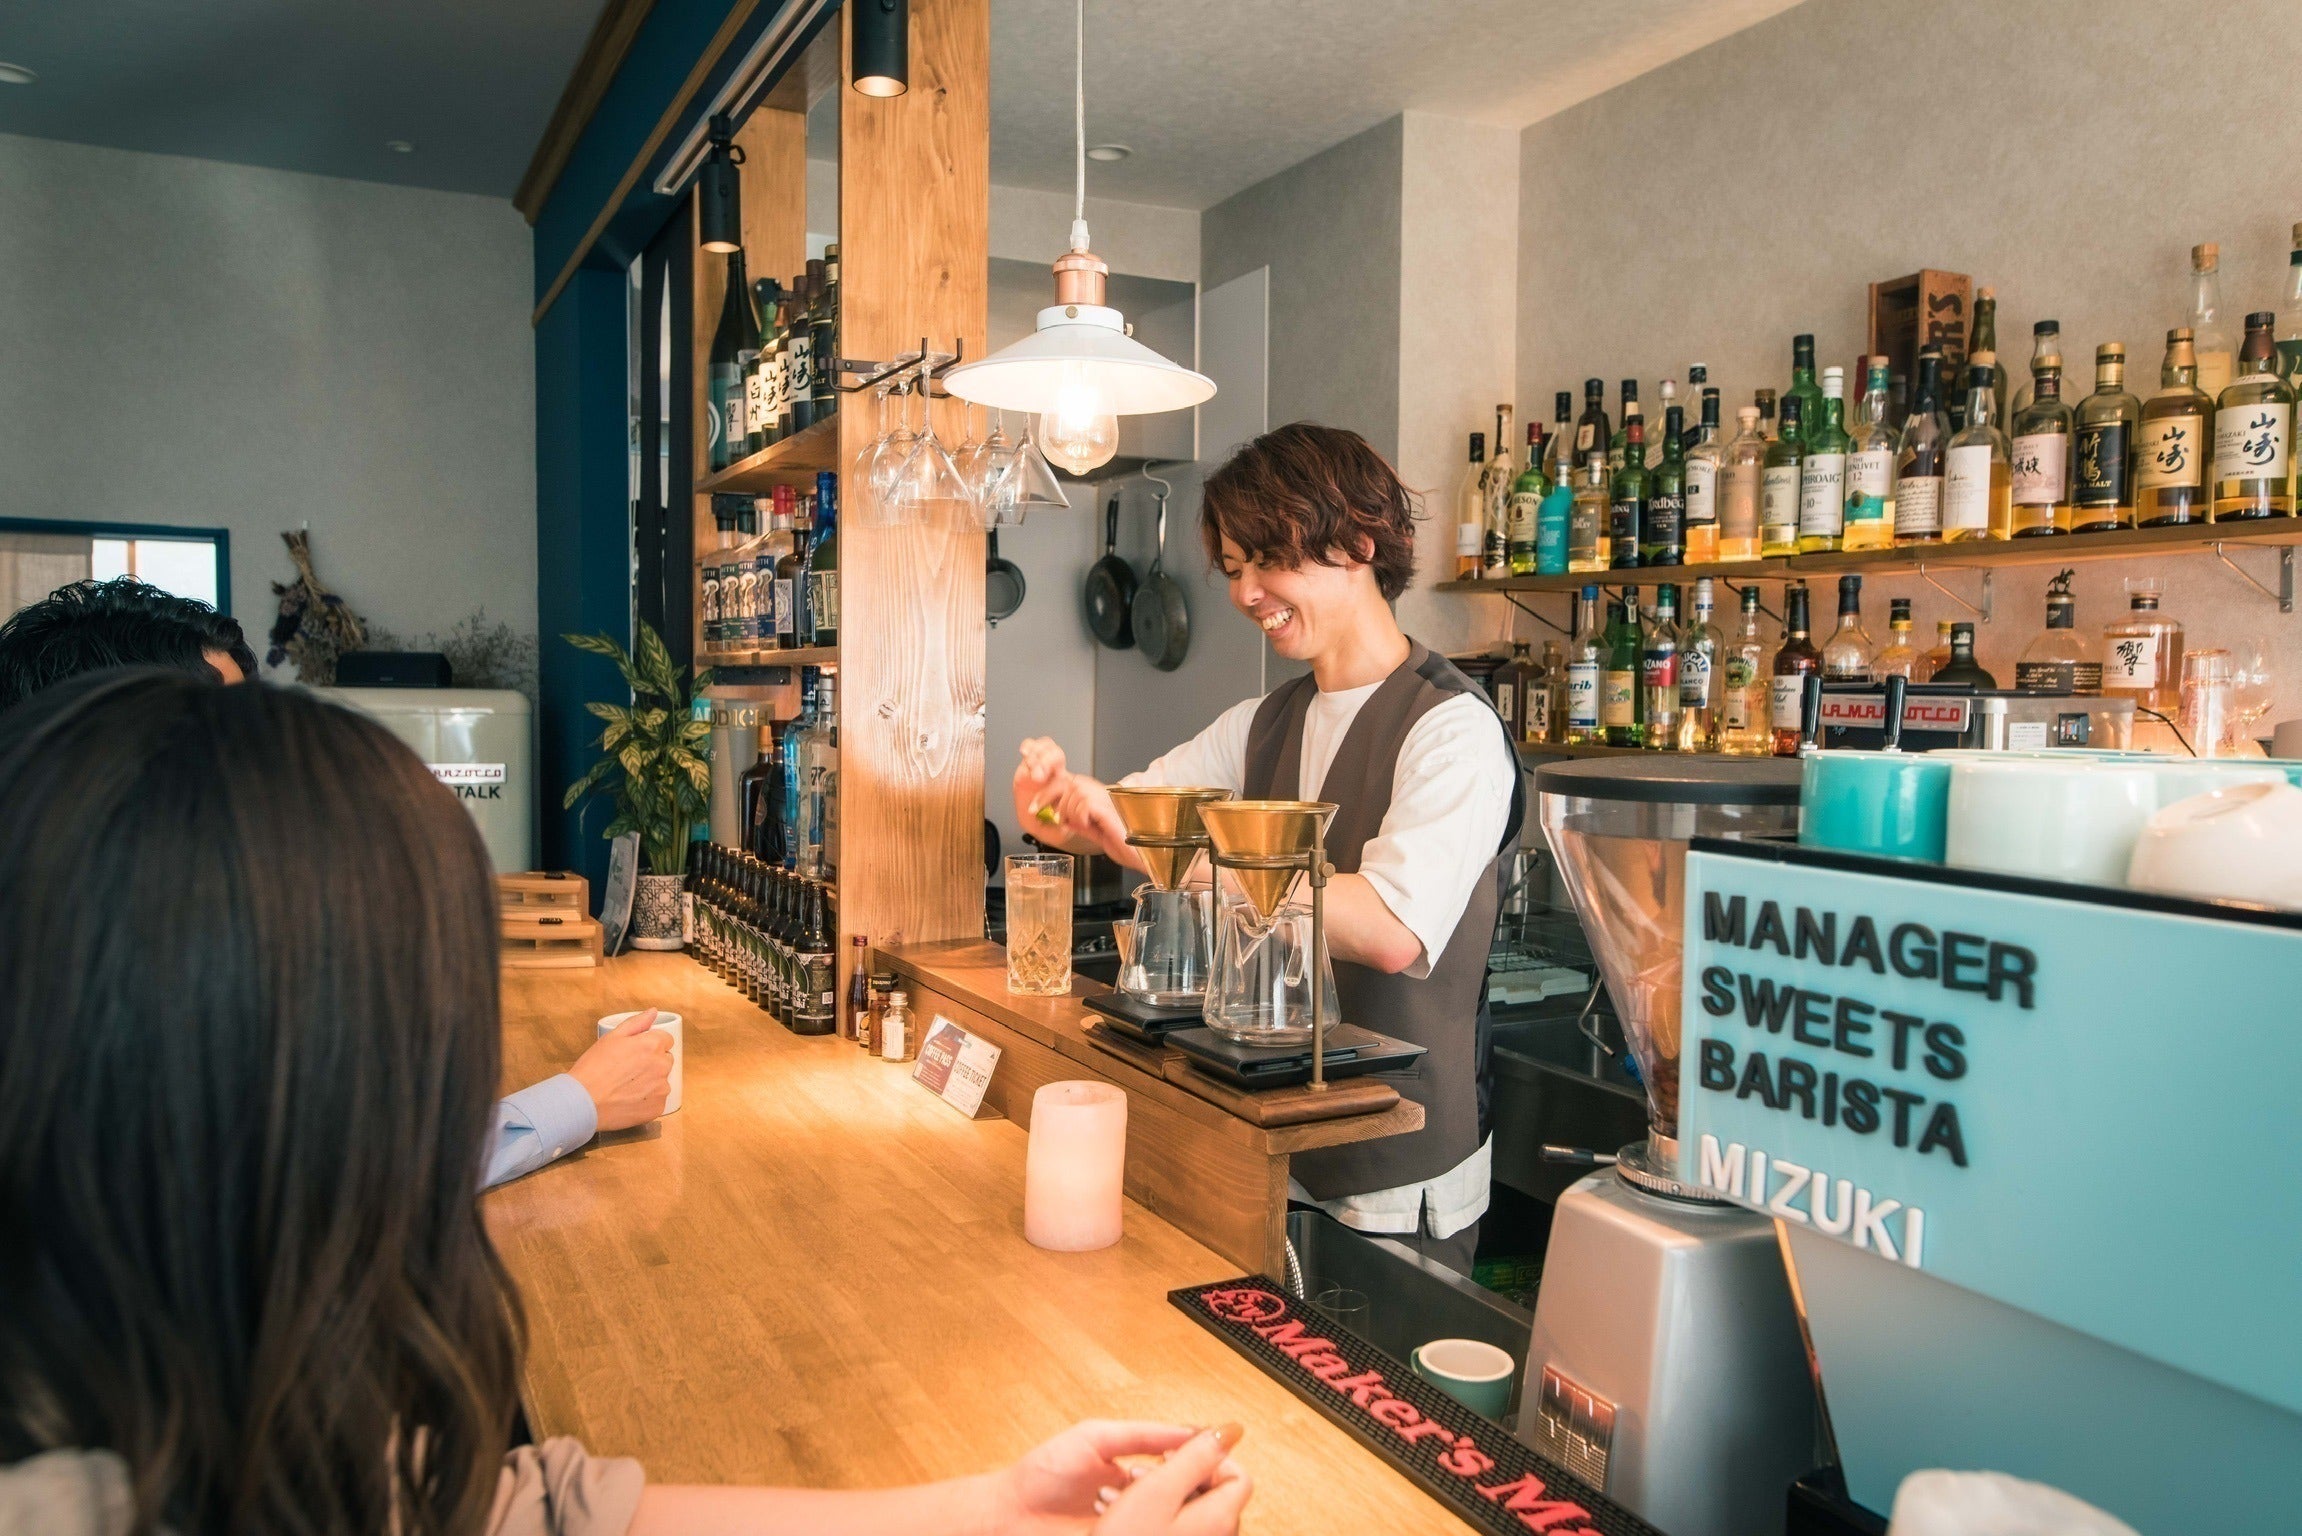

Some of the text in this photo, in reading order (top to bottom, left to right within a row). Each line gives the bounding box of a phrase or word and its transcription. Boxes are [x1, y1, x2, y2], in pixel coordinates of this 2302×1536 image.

[750, 381, 761, 422] 白州
[1853, 471, 1862, 481] 12
[1806, 498, 1815, 509] 10
[1847, 704, 1961, 723] MAOCCO
[454, 785, 502, 799] TALK
[1703, 891, 2038, 1010] MANAGER
[1701, 966, 1968, 1081] SWEETS
[925, 1043, 941, 1061] COFFEE
[953, 1060, 971, 1079] COFFEE
[969, 1069, 987, 1088] TICKET
[1700, 1038, 1969, 1168] BARISTA
[1701, 1134, 1925, 1269] MIZUKI
[1252, 1319, 1601, 1536] Maker's M
